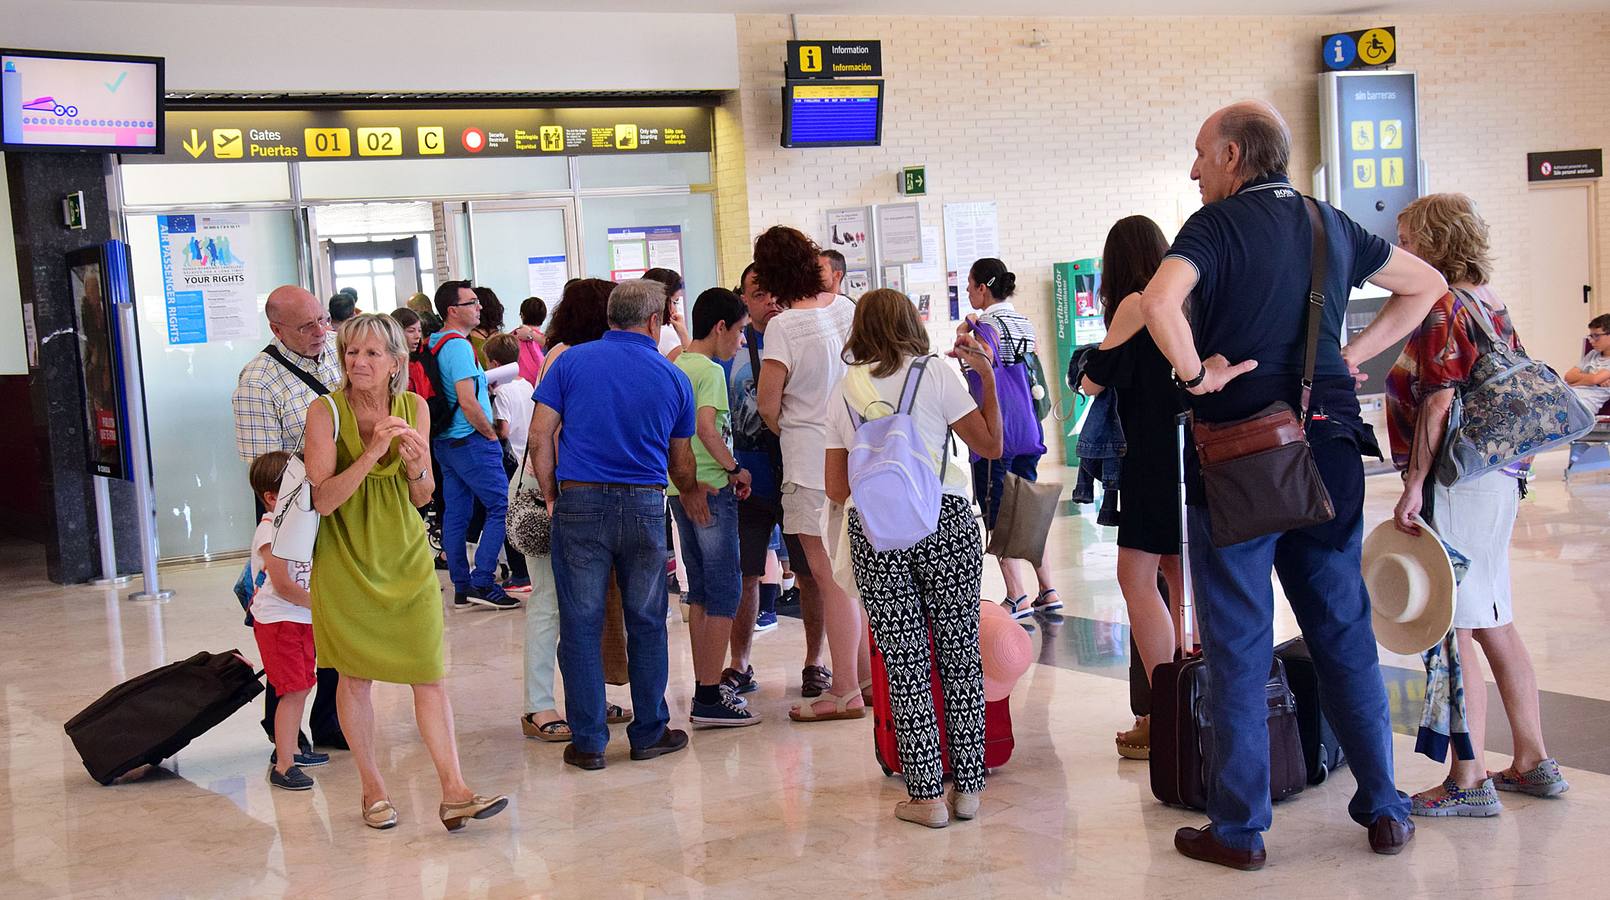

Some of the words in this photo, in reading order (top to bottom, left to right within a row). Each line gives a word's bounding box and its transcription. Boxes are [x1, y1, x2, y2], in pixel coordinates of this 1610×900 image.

[832, 46, 869, 54] Information
[832, 63, 872, 72] Información
[250, 129, 281, 141] Gates
[315, 133, 341, 151] 01
[366, 132, 393, 151] 02
[424, 131, 438, 150] C
[250, 144, 299, 157] Puertas
[160, 224, 169, 245] AIR
[168, 306, 180, 343] RIGHTS
[184, 276, 210, 284] YOUR
[212, 274, 245, 283] RIGHTS
